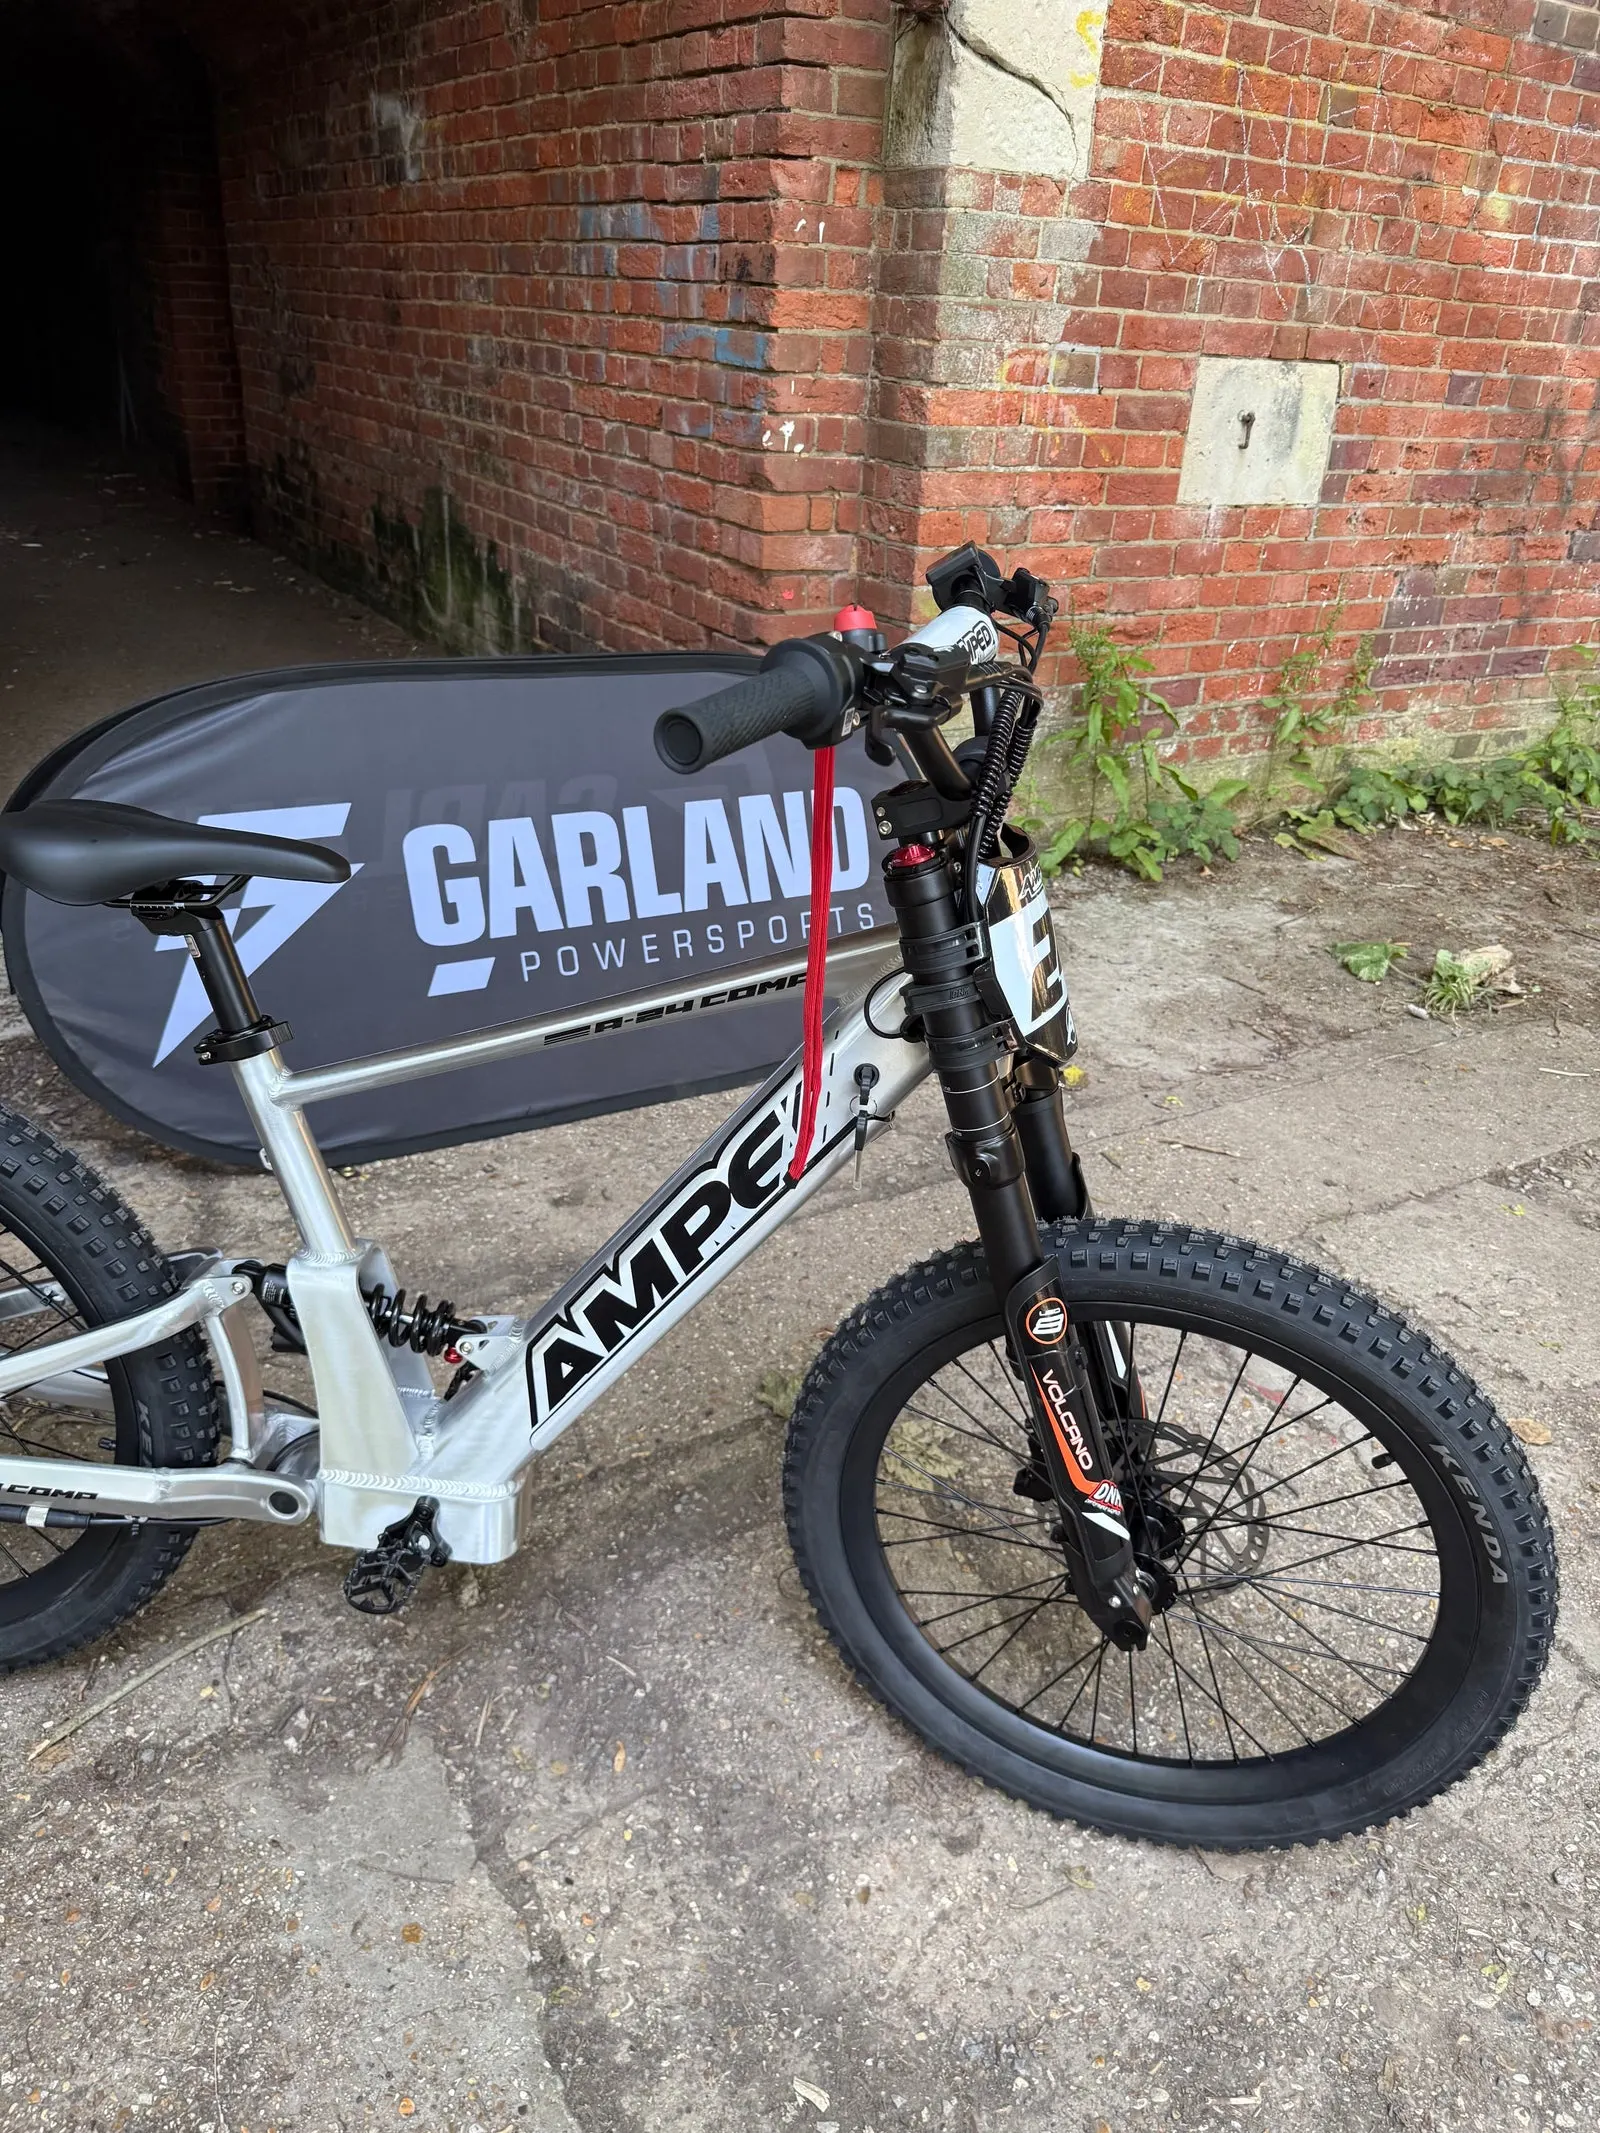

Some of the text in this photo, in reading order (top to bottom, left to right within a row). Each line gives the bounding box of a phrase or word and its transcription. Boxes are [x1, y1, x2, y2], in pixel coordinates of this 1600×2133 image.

[402, 786, 871, 947] GARLAND
[1042, 1368, 1094, 1470] VOLCANO
[7, 1484, 98, 1500] COMP
[1428, 1442, 1509, 1583] KENDA
